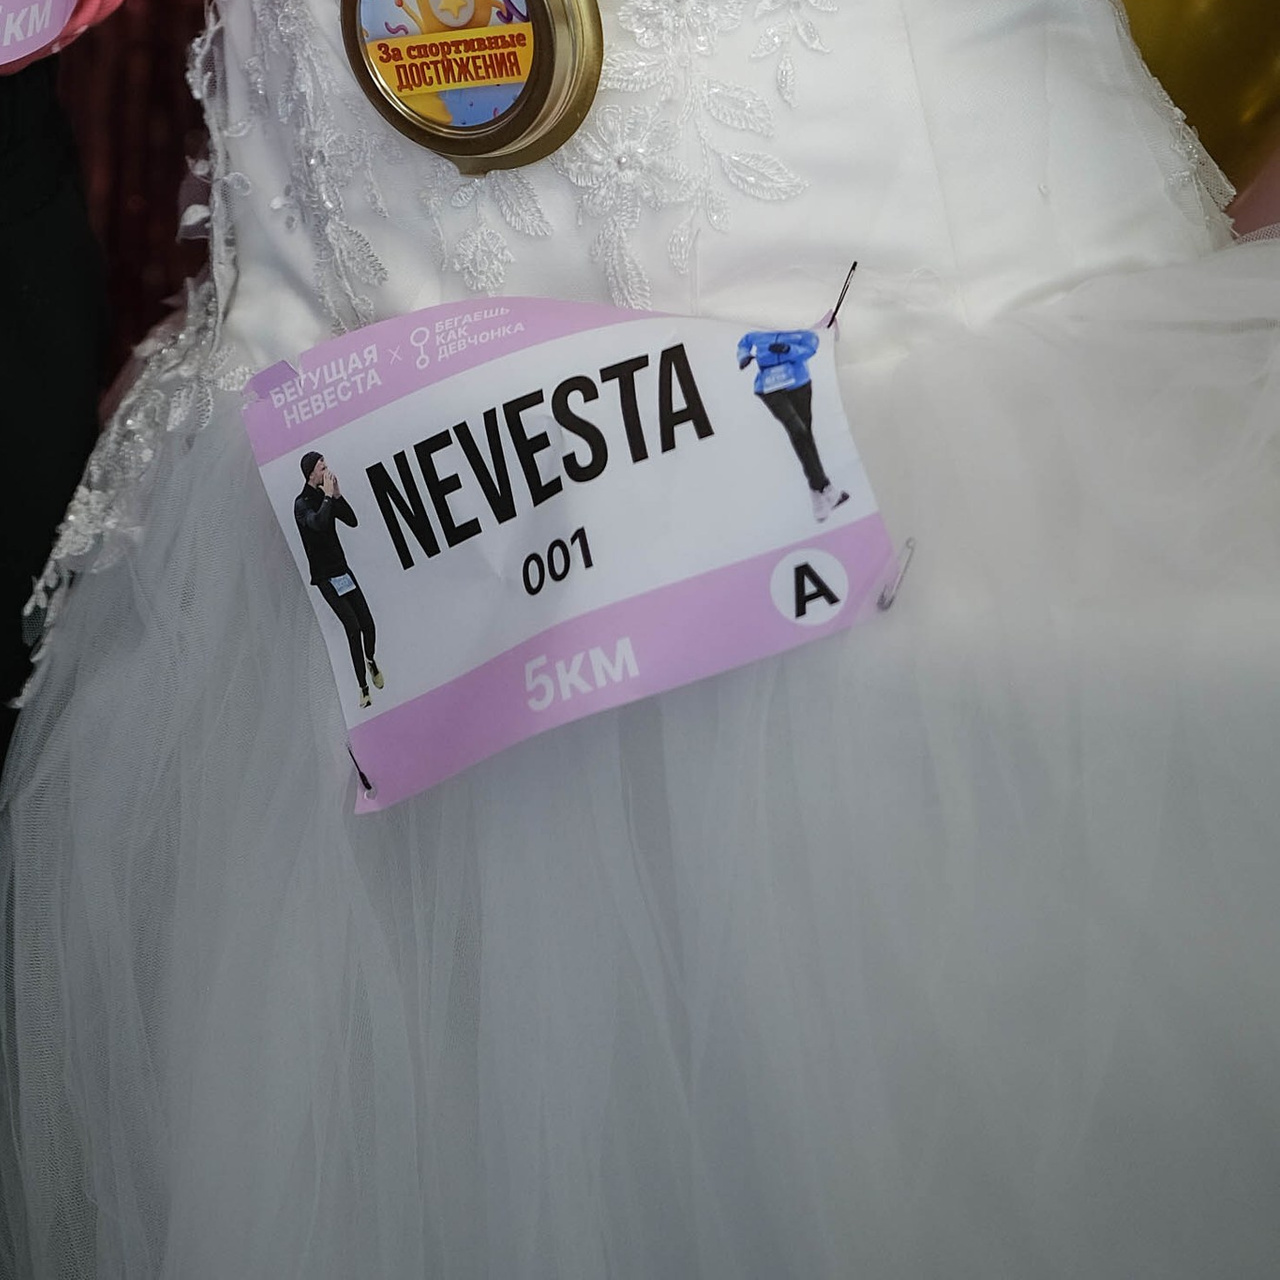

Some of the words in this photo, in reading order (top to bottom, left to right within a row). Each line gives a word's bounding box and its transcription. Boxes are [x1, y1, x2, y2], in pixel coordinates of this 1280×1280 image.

[377, 42, 403, 63] За
[406, 31, 527, 58] спортивные
[395, 50, 522, 92] ДОСТИЖЕНИЯ
[434, 306, 511, 334] БЕГАЕШЬ
[434, 325, 469, 345] КАК
[437, 321, 525, 363] ДЕВЧОНКА
[269, 343, 379, 409] БЕГУЩАЯ
[283, 368, 383, 430] НЕВЕСТА
[365, 342, 715, 571] NEVESTA
[521, 526, 594, 597] 001
